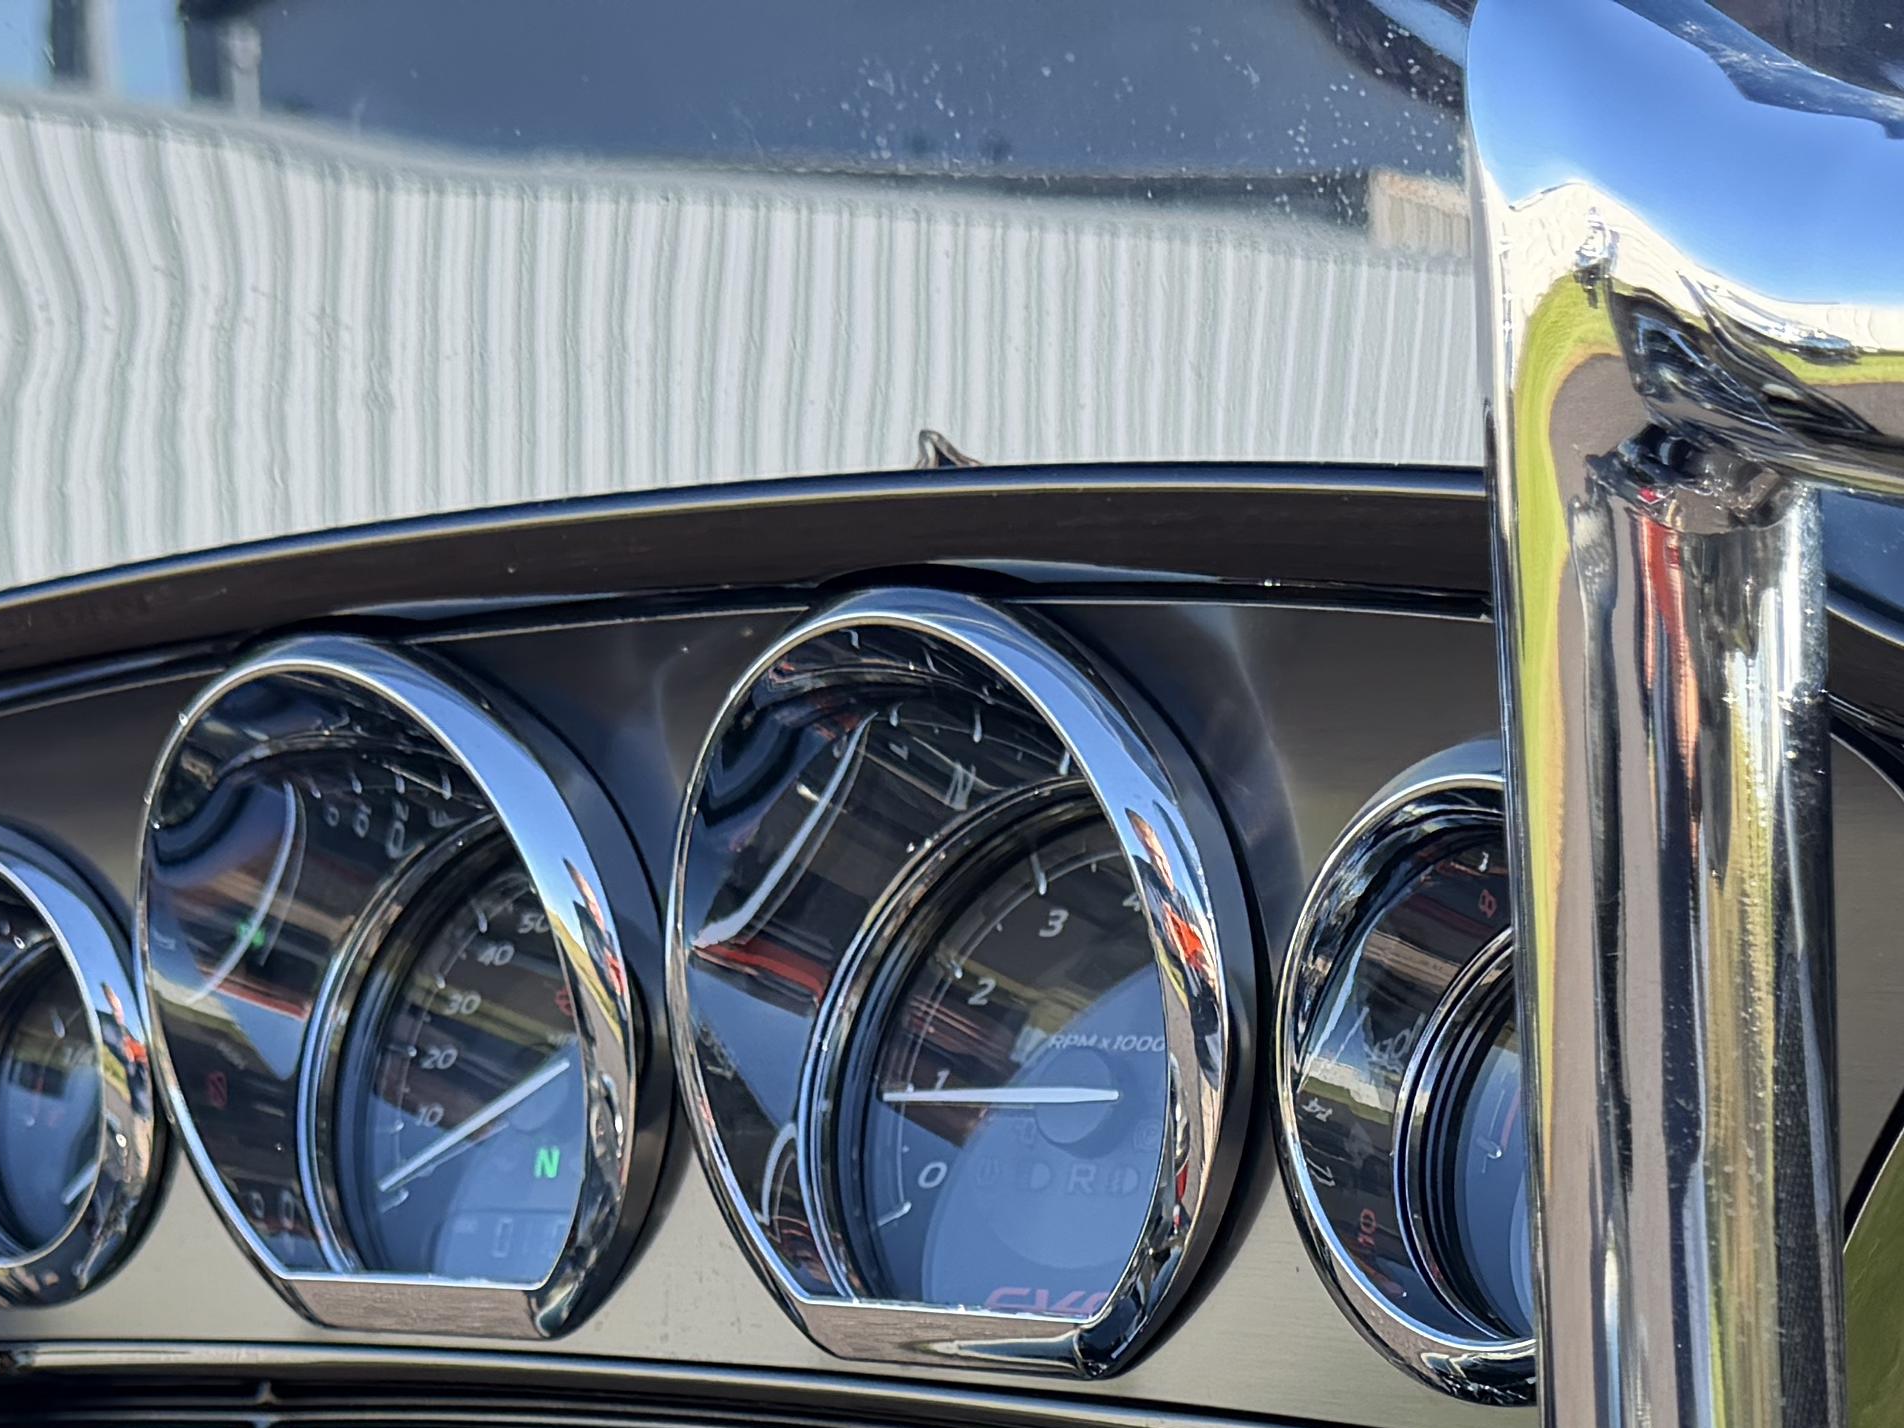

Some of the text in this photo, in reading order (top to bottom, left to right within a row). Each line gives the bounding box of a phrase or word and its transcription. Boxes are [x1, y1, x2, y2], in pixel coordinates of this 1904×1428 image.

[1039, 909, 1069, 938] 3
[478, 944, 516, 966] 40
[968, 977, 997, 1006] 2
[444, 994, 482, 1016] 30
[1048, 1033, 1097, 1049] RPM
[421, 1047, 459, 1070] 20
[933, 1069, 951, 1090] 1
[415, 1105, 445, 1128] 10
[534, 1147, 562, 1179] N
[917, 1161, 948, 1190] 0
